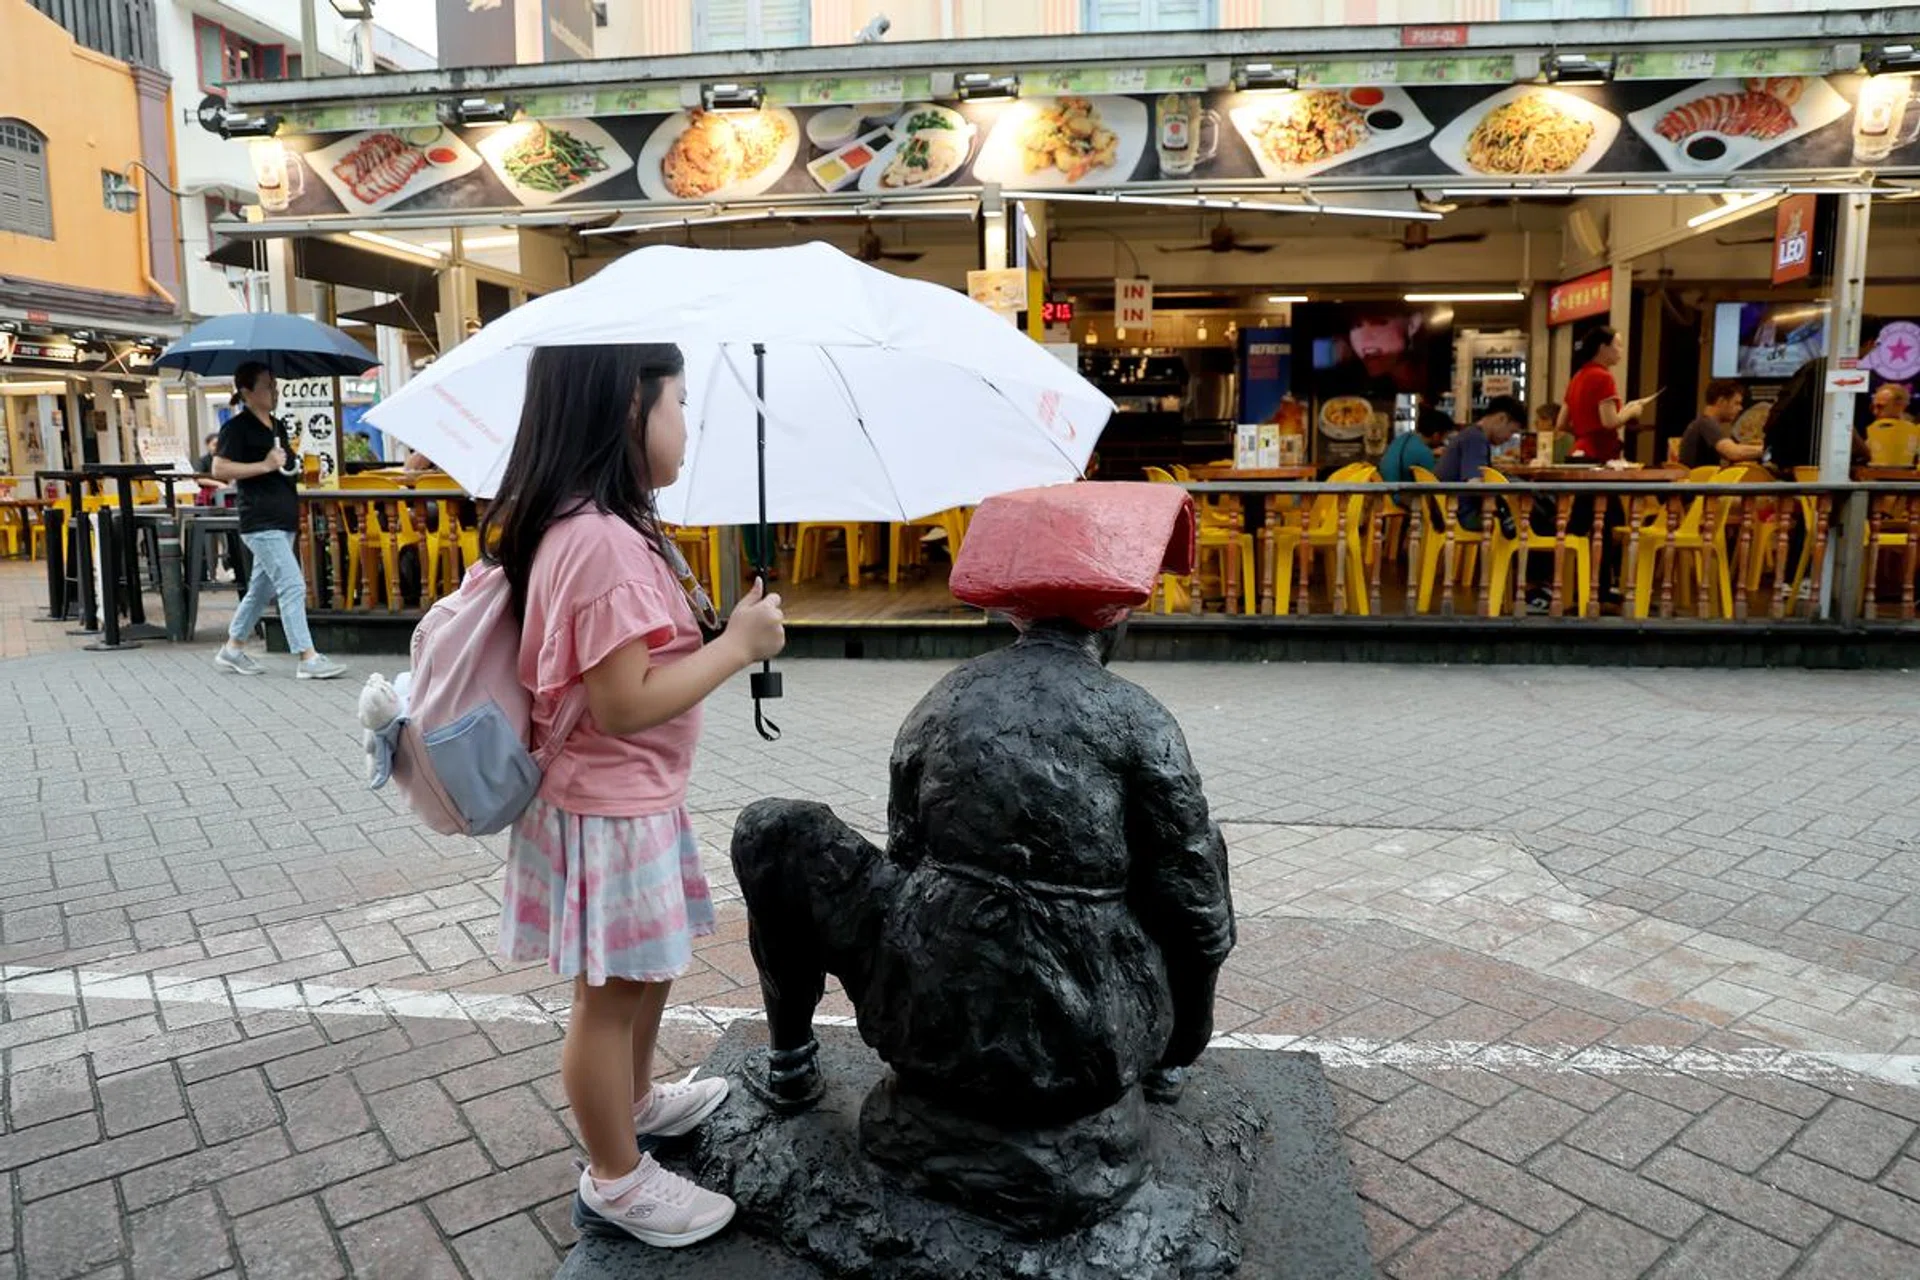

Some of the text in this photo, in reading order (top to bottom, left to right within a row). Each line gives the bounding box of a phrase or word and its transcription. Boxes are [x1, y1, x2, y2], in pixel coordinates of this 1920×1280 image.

[1779, 237, 1805, 265] LEO
[1123, 285, 1145, 299] IN
[1123, 308, 1145, 322] IN
[282, 381, 330, 399] CLOCK
